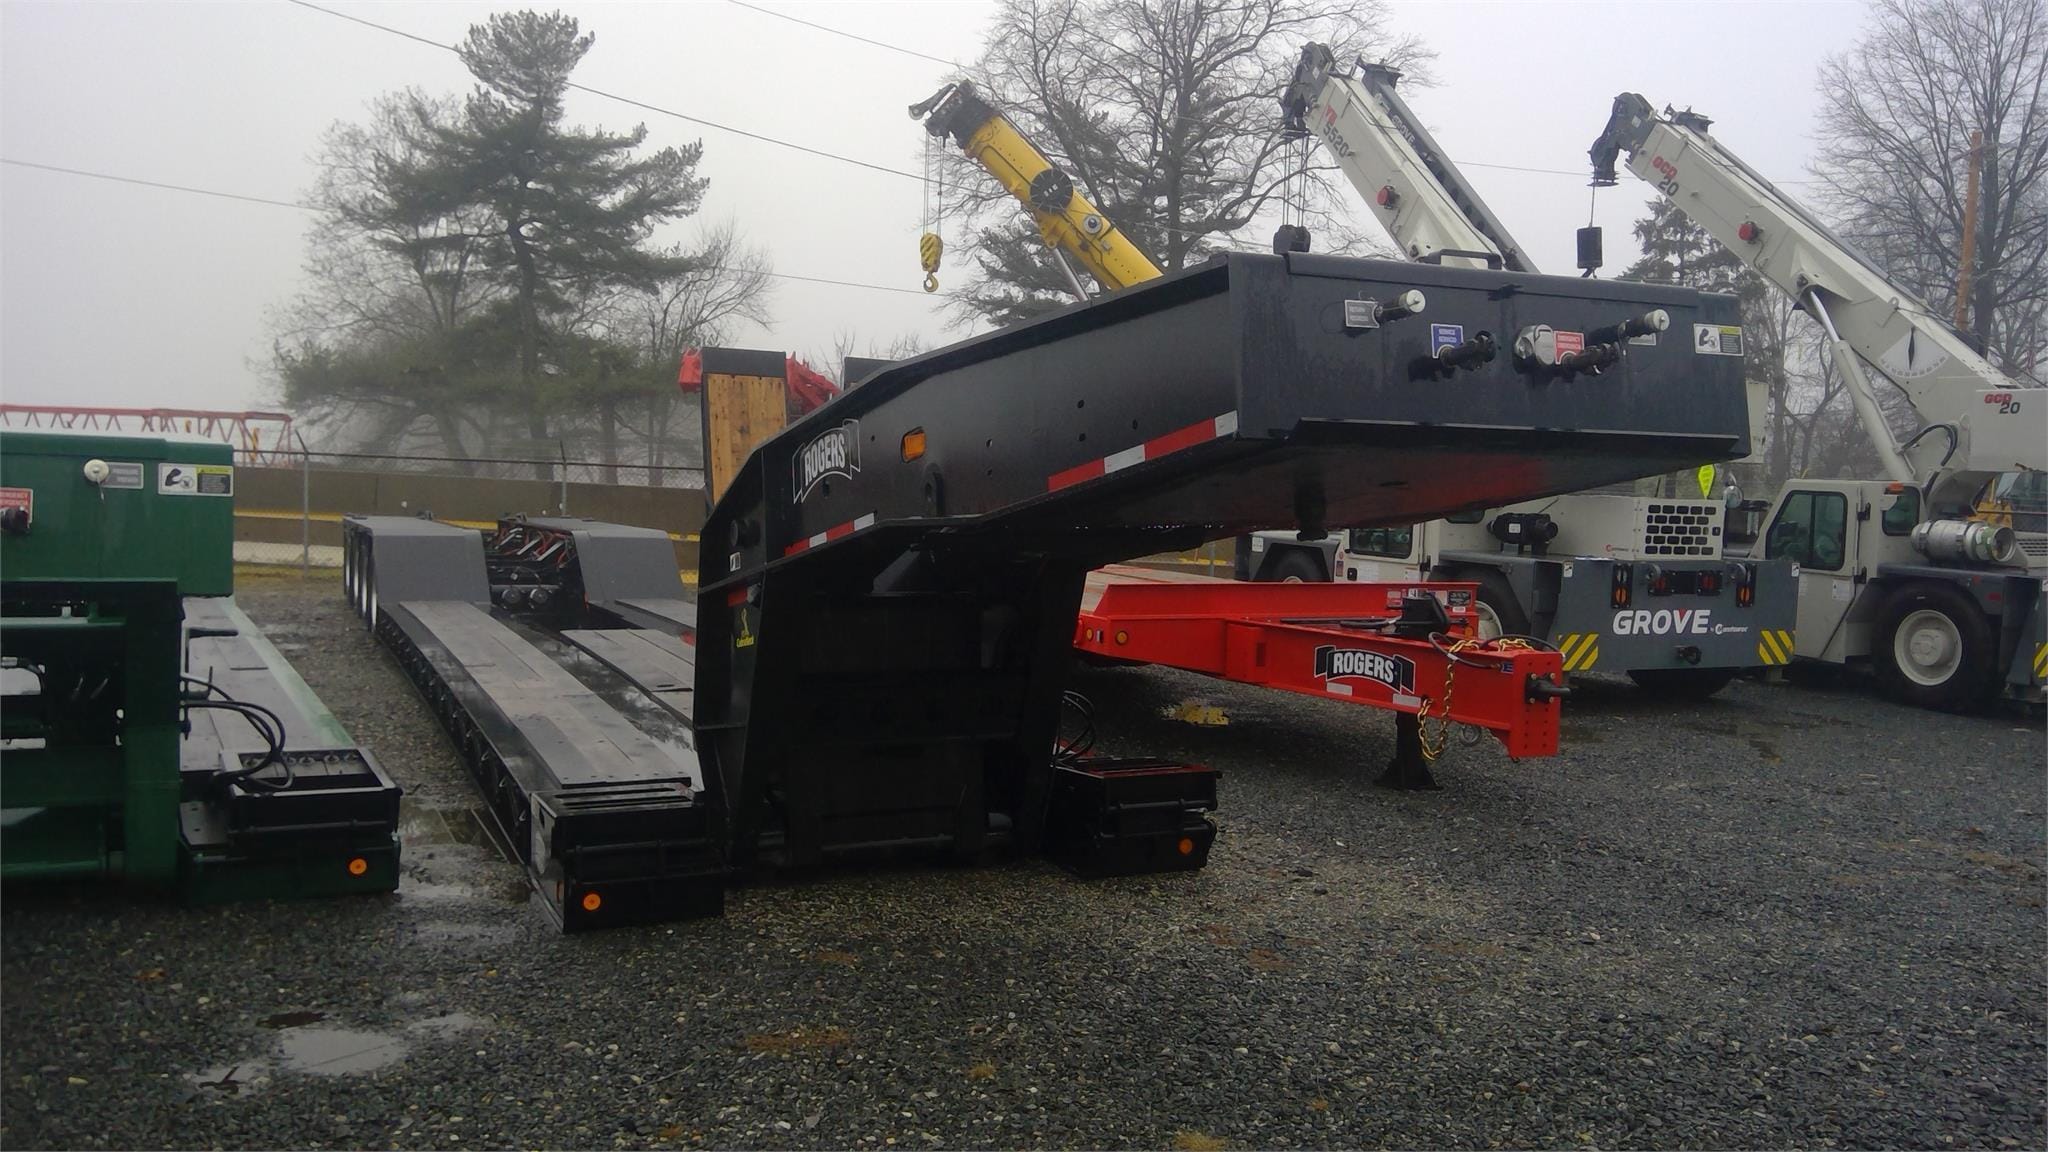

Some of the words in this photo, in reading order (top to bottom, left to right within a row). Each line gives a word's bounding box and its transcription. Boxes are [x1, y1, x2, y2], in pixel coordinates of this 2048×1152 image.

[1323, 121, 1350, 158] 5520
[1658, 176, 1680, 197] 20
[1999, 402, 2021, 414] 20
[804, 432, 846, 487] ROGERS
[1612, 609, 1711, 635] GROVE
[1333, 652, 1395, 683] ROGERS
